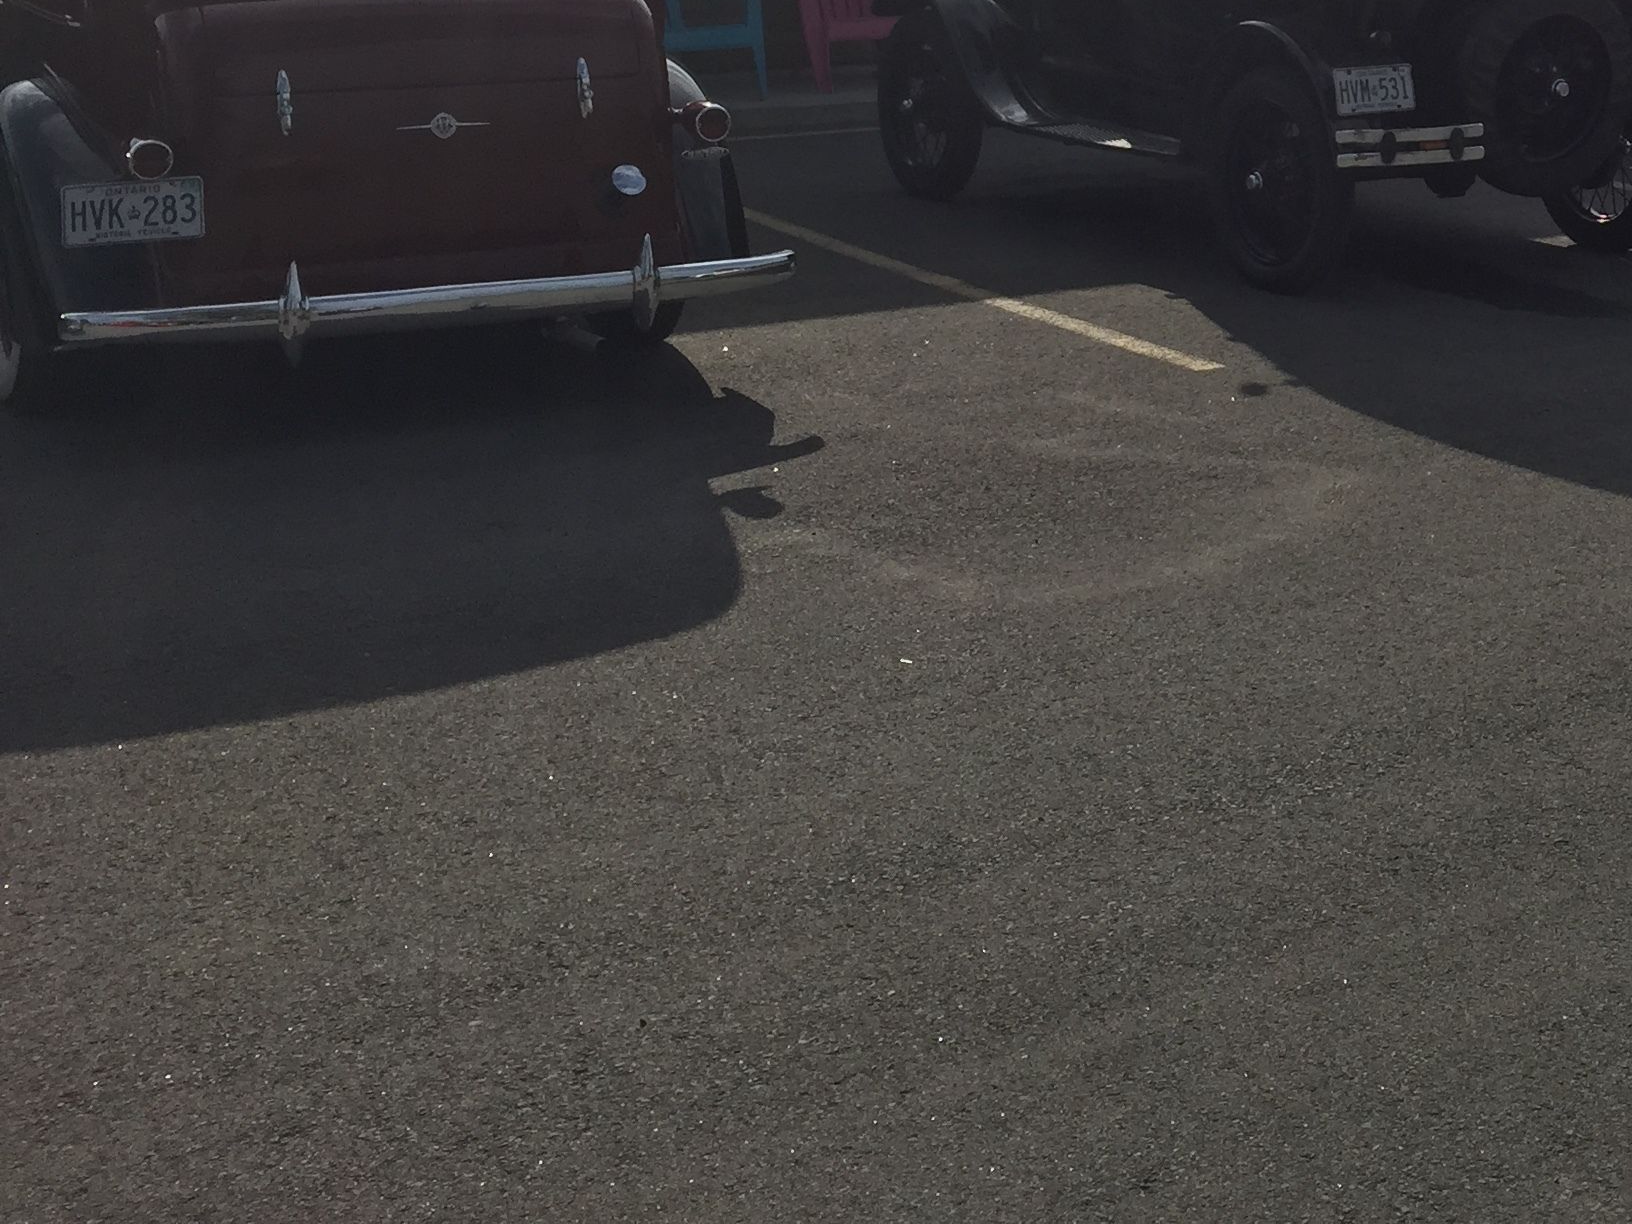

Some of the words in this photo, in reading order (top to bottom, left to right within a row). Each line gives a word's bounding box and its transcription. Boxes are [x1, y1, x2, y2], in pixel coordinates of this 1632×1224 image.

[1339, 78, 1371, 104] HVM
[1379, 77, 1409, 101] 531
[105, 184, 161, 197] ONTARIO
[70, 197, 125, 232] HVK
[143, 192, 197, 226] 283
